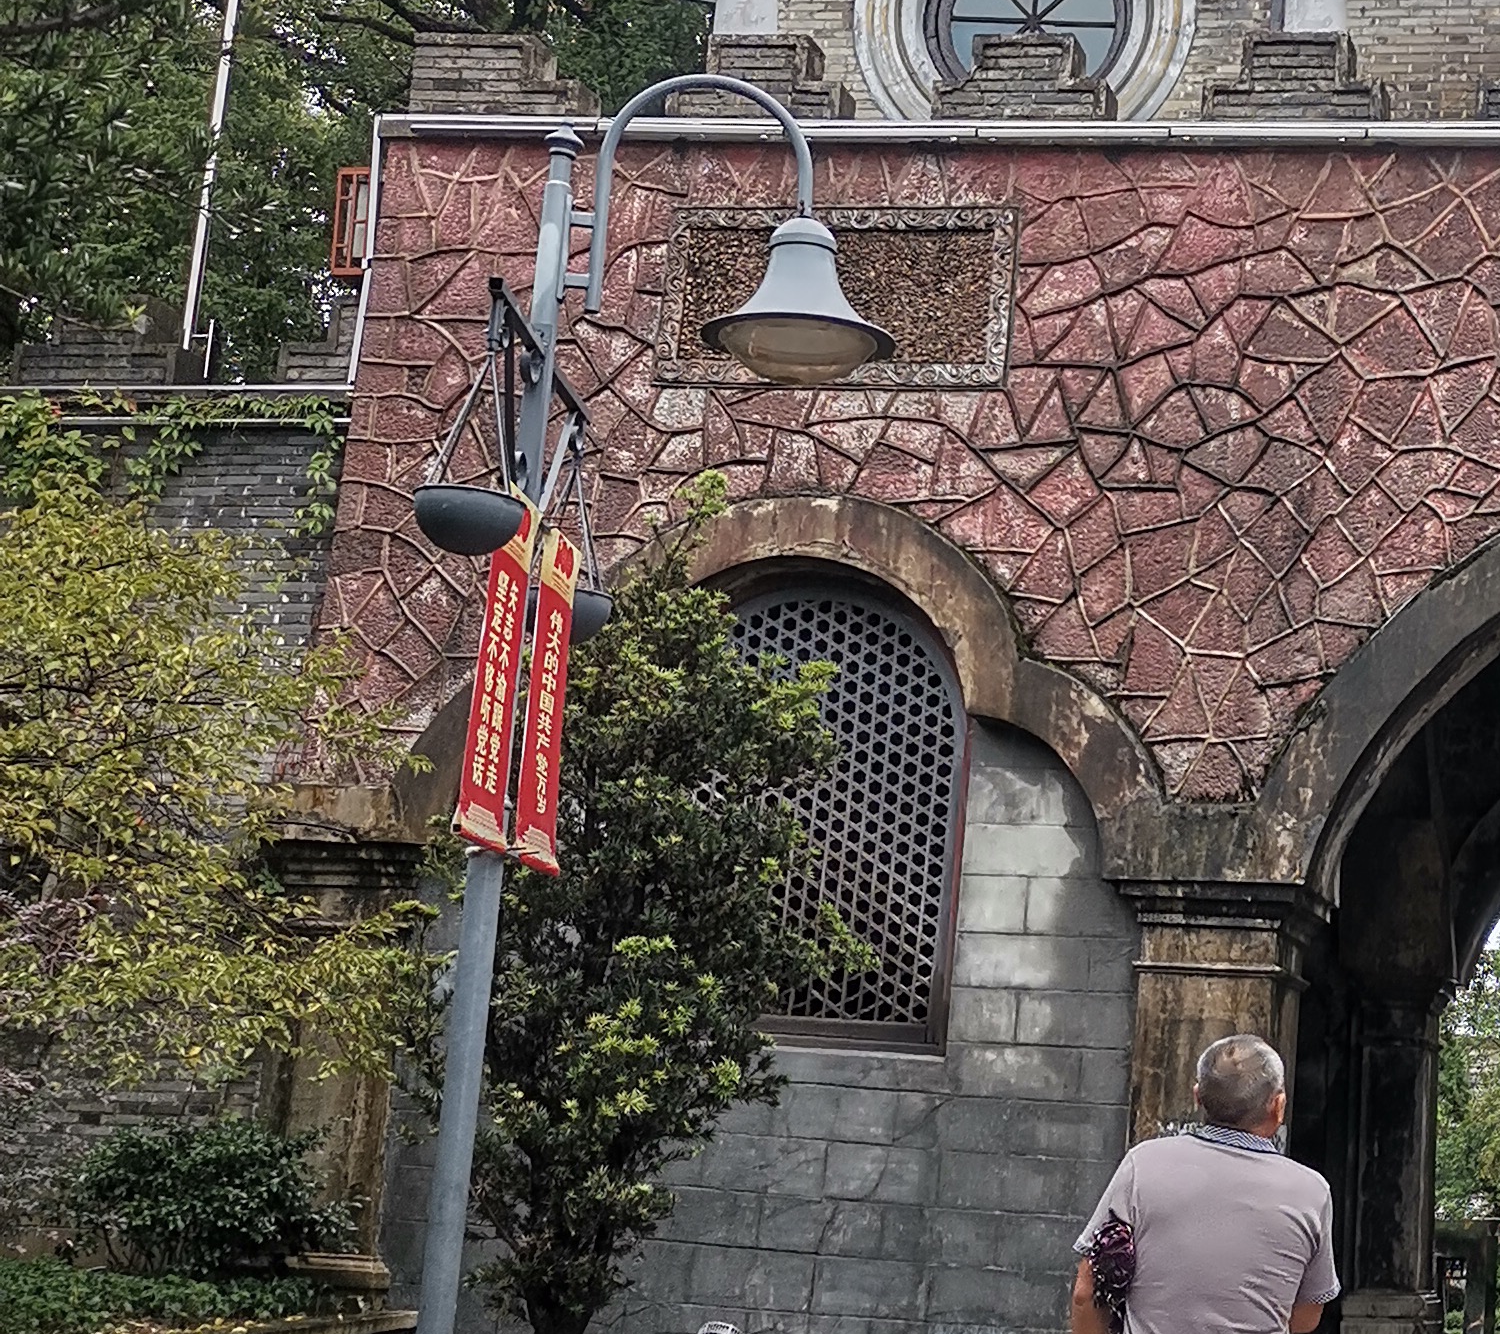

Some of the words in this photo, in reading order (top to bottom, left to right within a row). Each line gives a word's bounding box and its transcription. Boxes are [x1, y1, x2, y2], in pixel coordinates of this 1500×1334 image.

[472, 570, 510, 787] 坚定不移听党话
[484, 580, 519, 794] 矢志不渝跟党走
[536, 609, 564, 814] 伟大的中国共产党万岁
